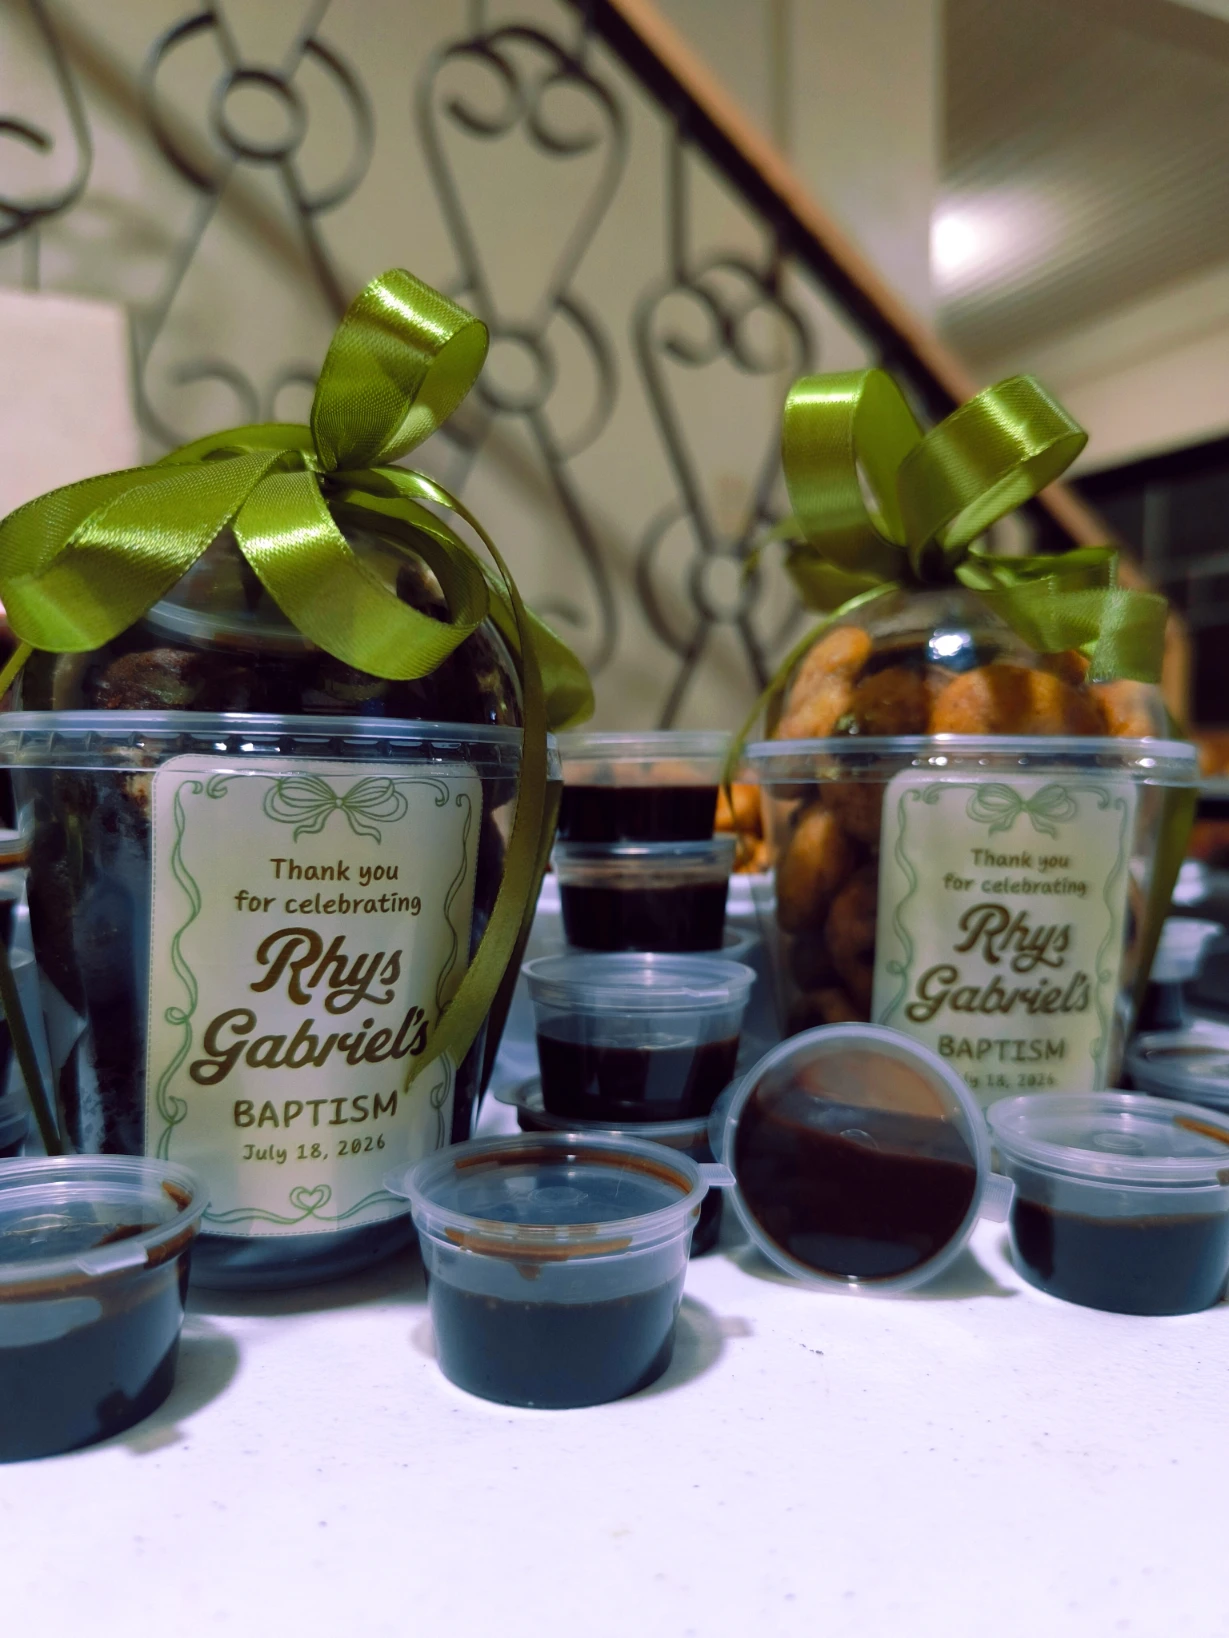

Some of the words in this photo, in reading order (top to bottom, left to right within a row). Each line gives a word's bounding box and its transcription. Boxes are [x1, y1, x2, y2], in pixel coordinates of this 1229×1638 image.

[270, 858, 351, 882] Thank
[359, 864, 399, 887] you
[970, 848, 1031, 869] Thank
[1038, 855, 1070, 873] you
[943, 873, 974, 891] for
[981, 876, 1087, 898] celebrating
[234, 889, 275, 914] for
[285, 891, 422, 917] celebrating
[953, 902, 1071, 973] Rhys
[250, 926, 403, 1015] Rhys
[904, 964, 1091, 1023] Gabriel's
[189, 1005, 430, 1086] Gabriel's
[938, 1034, 1066, 1061] BAPTISM
[234, 1090, 399, 1129] BAPTISM
[242, 1143, 287, 1164] July
[297, 1142, 330, 1161] 18,
[338, 1135, 386, 1155] 2026
